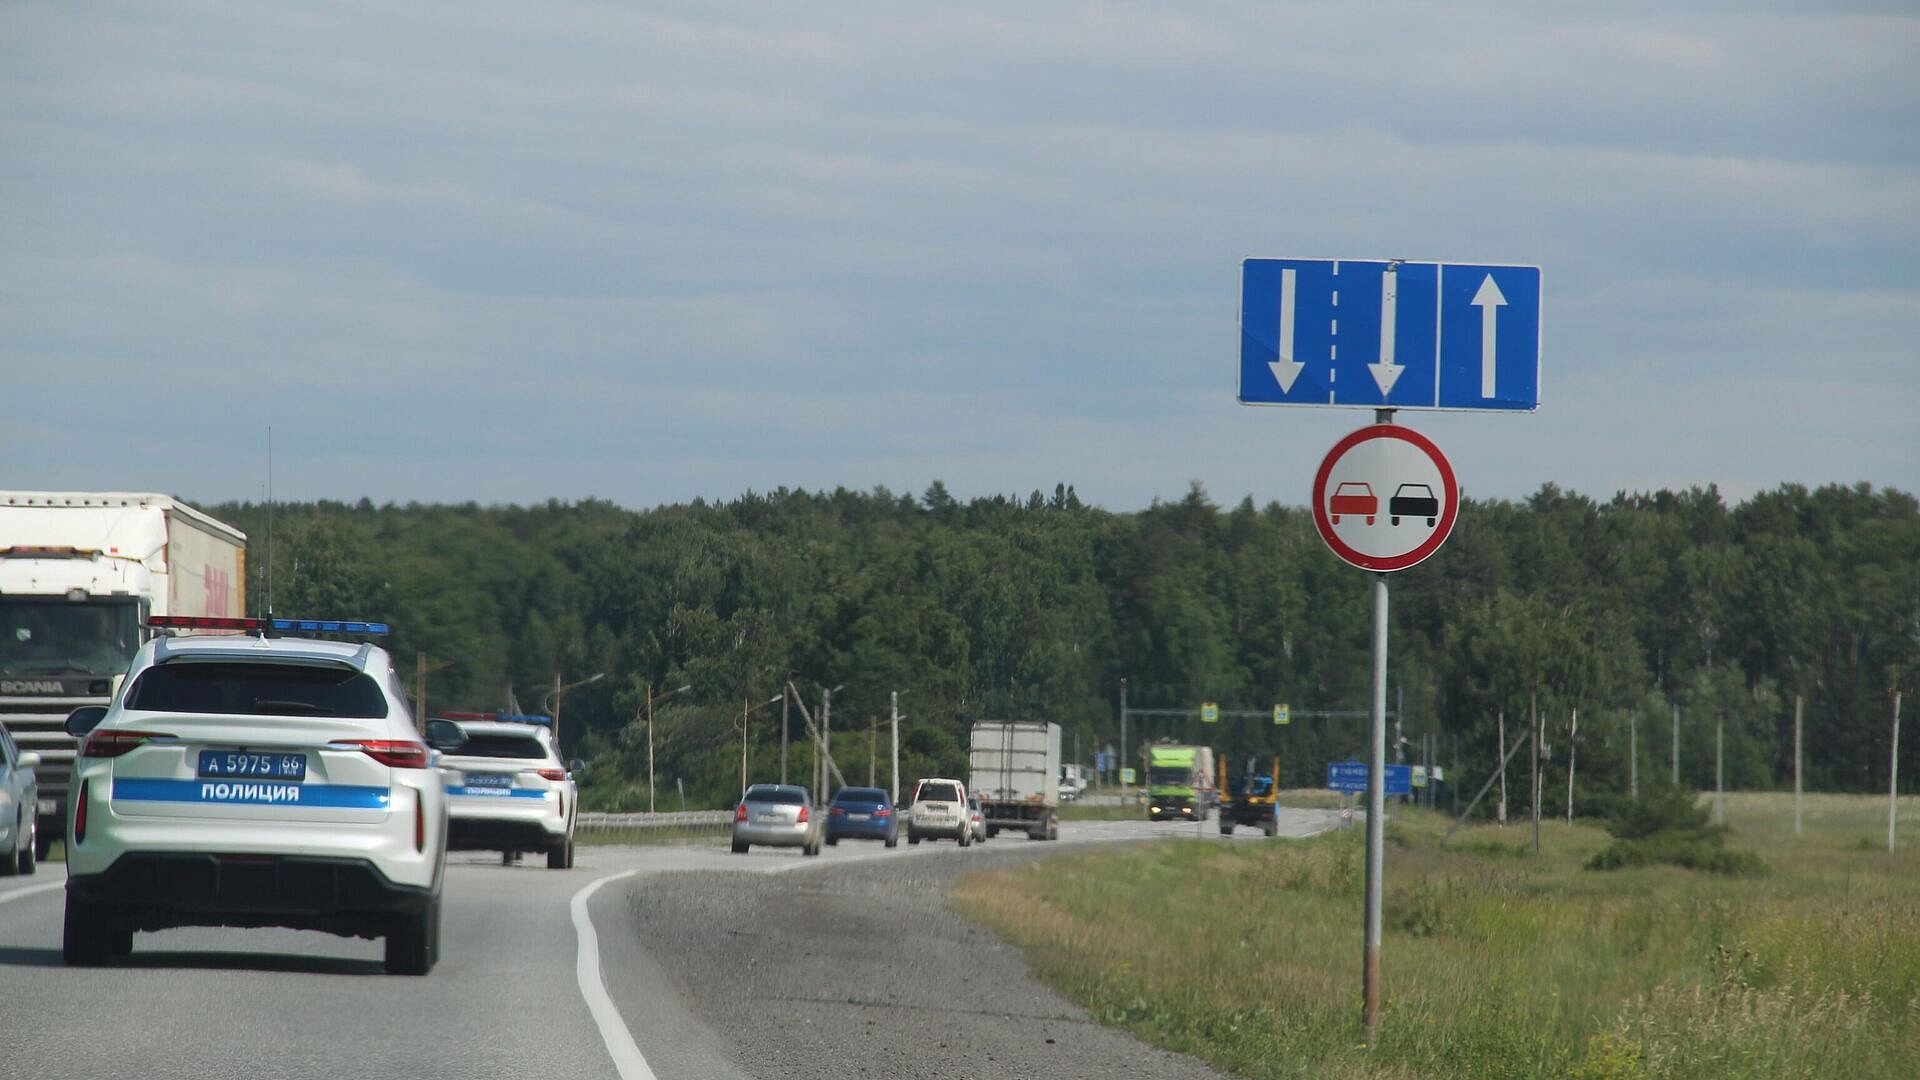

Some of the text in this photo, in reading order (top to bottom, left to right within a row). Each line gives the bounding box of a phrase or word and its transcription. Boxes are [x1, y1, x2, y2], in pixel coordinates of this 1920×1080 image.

[1, 680, 64, 693] SCANIA
[226, 755, 271, 774] 5975
[282, 756, 299, 769] 66
[201, 784, 299, 802] ПОЛИЦИЯ
